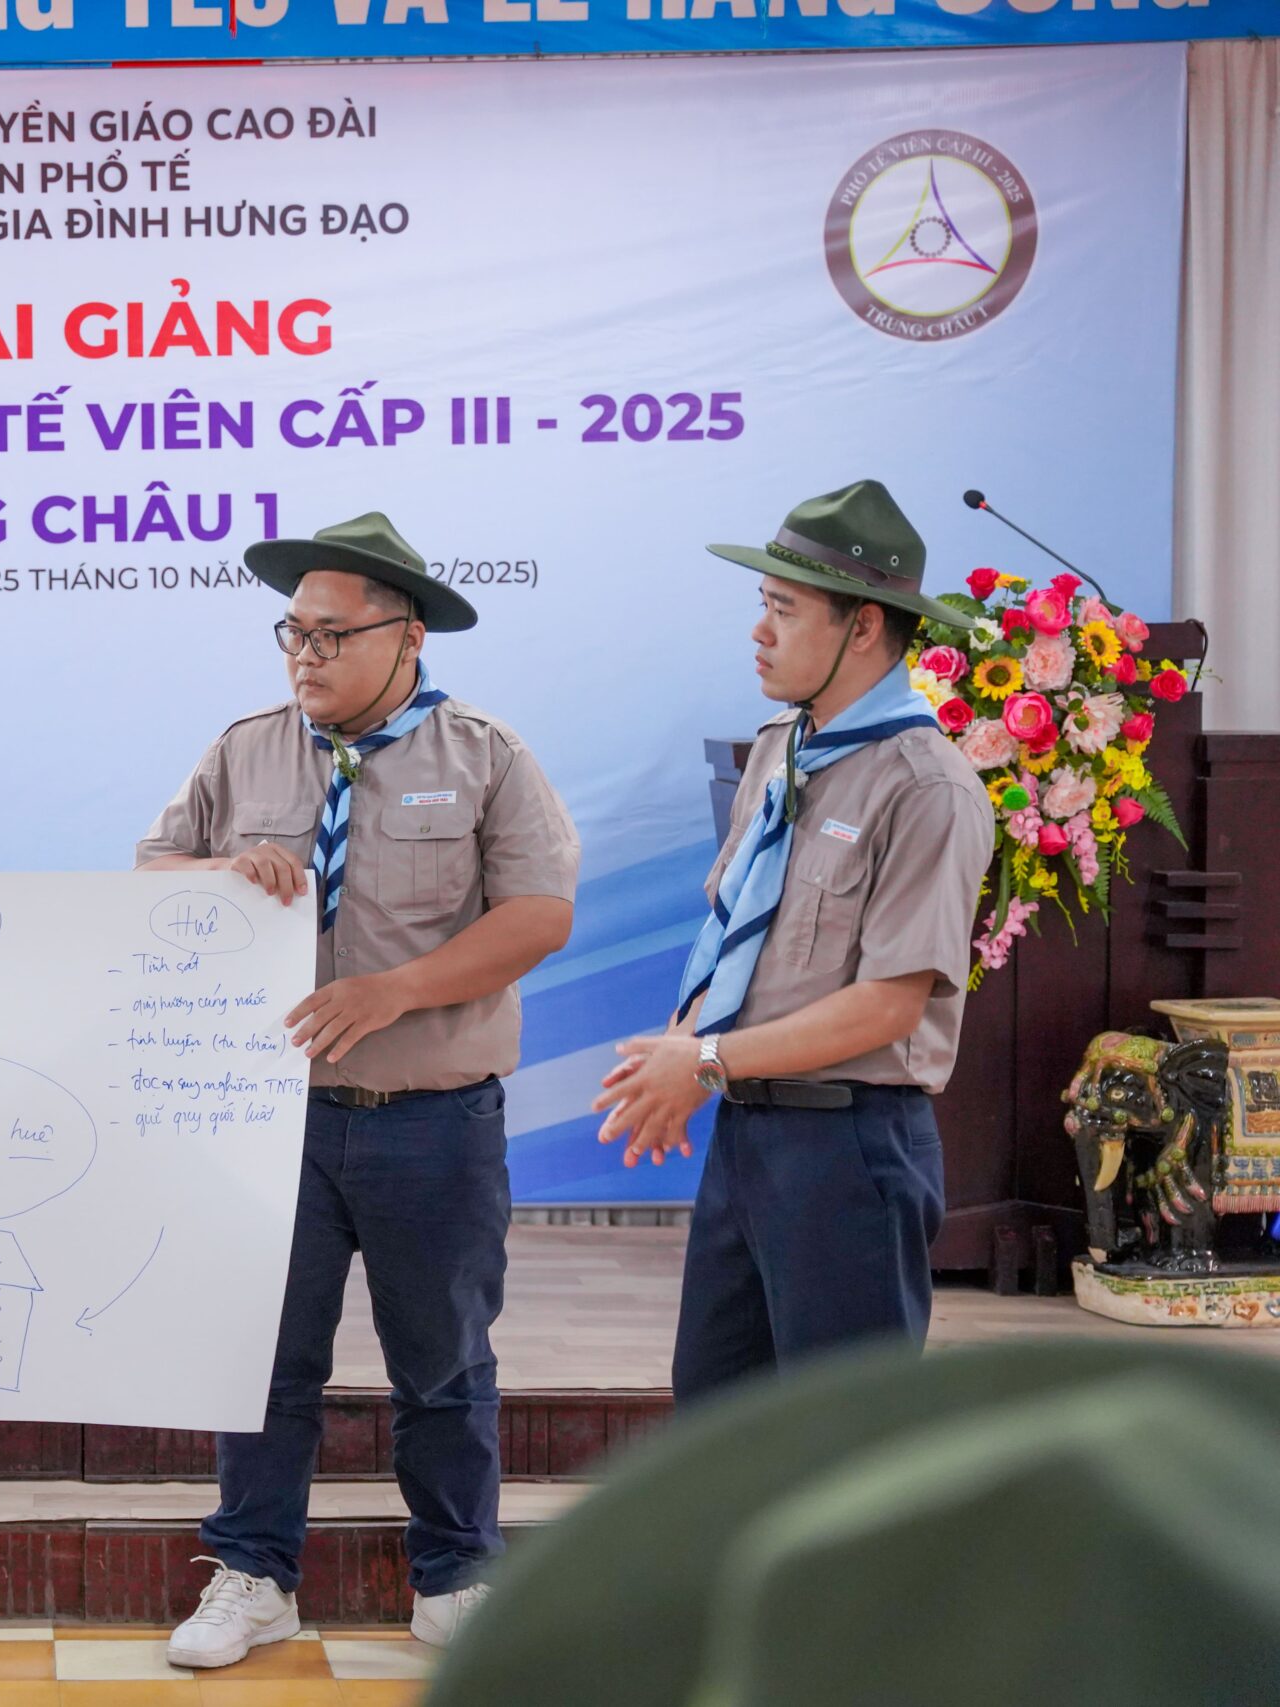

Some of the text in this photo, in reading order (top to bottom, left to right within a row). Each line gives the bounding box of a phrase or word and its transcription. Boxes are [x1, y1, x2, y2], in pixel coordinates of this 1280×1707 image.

[89, 101, 193, 143] GIÁO
[207, 106, 294, 141] CAO
[307, 98, 377, 139] ĐÀI
[40, 149, 128, 193] PHỔ
[141, 148, 191, 192] TẾ
[996, 171, 1024, 203] 2025
[65, 199, 170, 239] ĐÌNH
[184, 199, 307, 237] HƯNG
[321, 202, 409, 243] ĐẠO
[64, 278, 333, 359] GIẢNG
[88, 388, 256, 451] VIÊN
[278, 378, 426, 449] CẤP
[451, 397, 511, 446] III
[580, 392, 745, 442] 2025
[31, 481, 231, 545] CHÂU
[28, 562, 140, 591] THÁNG
[150, 567, 179, 591] 10
